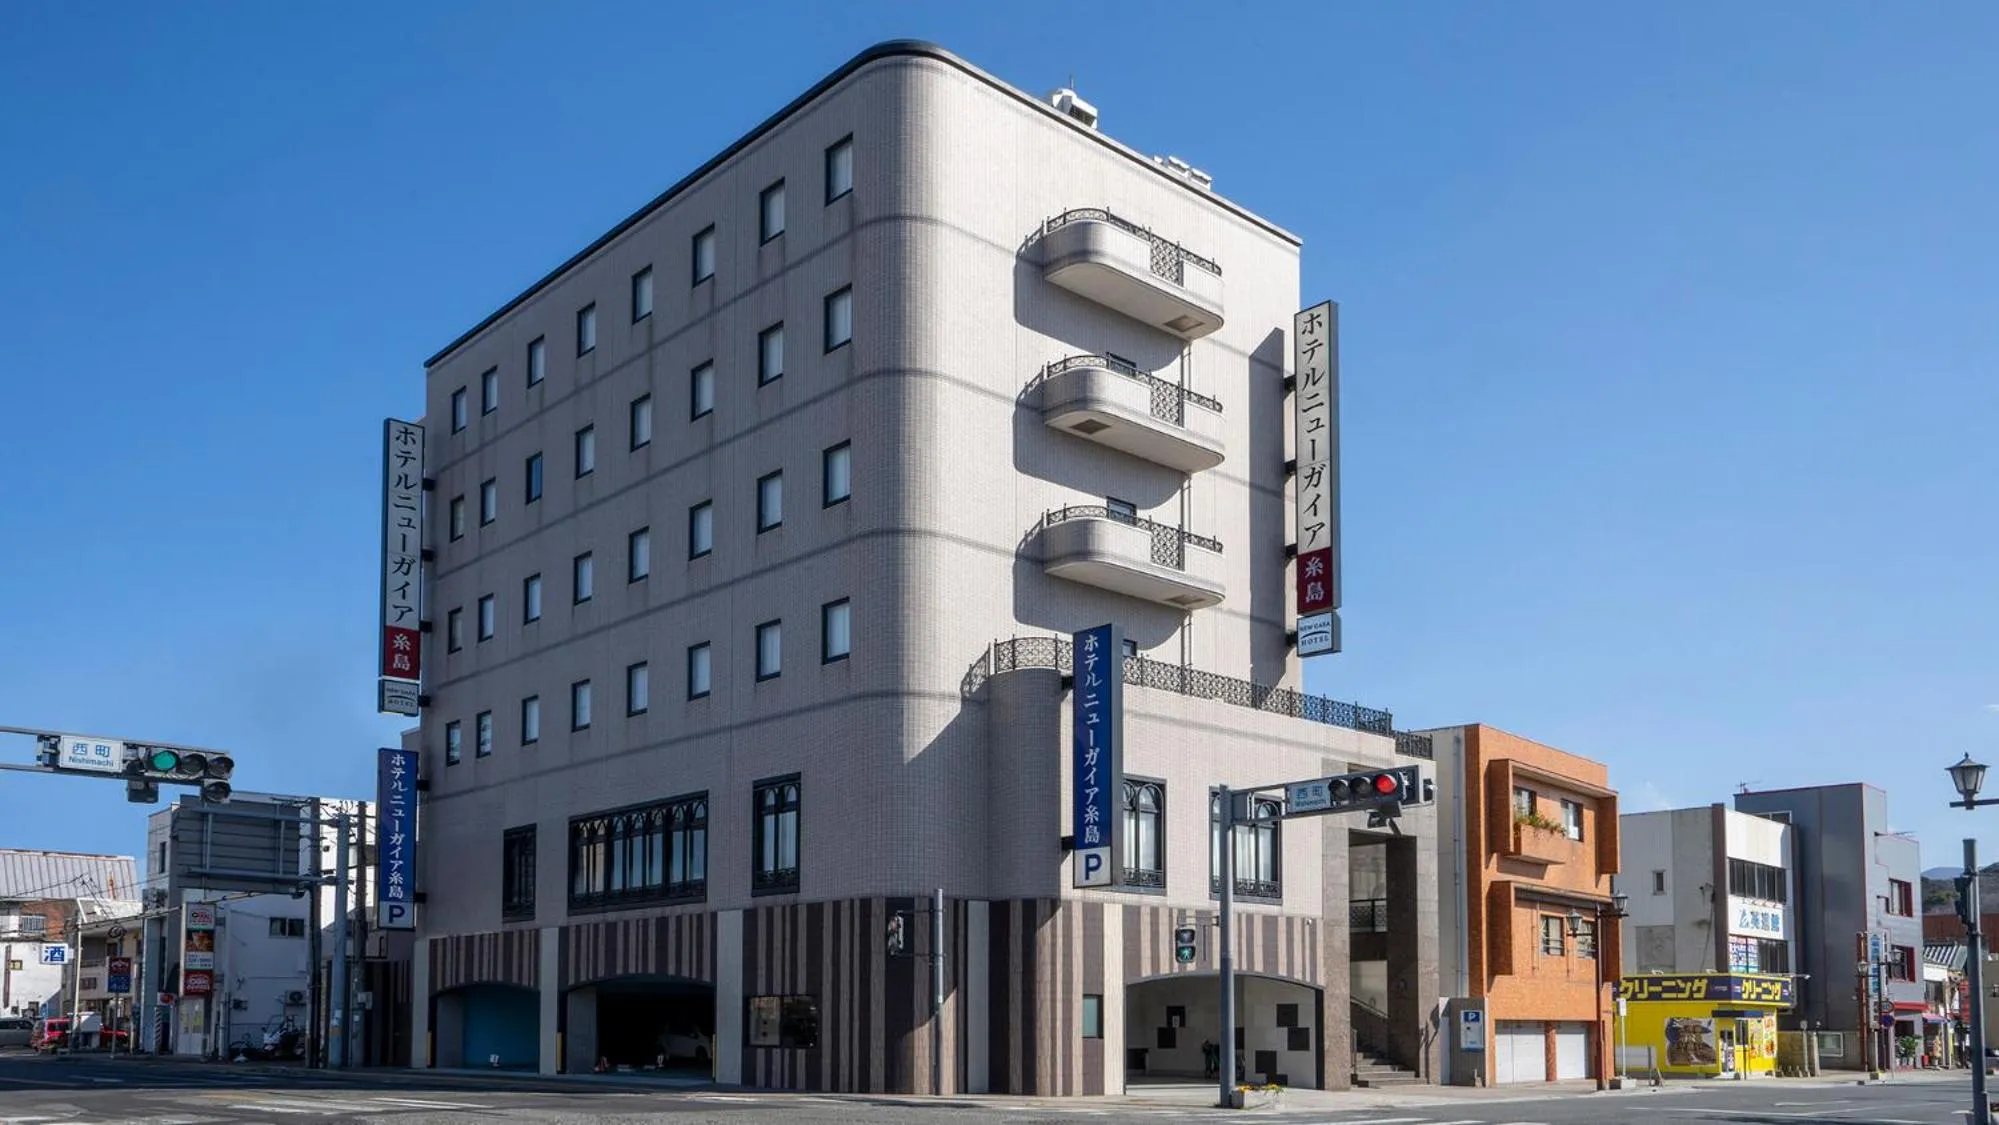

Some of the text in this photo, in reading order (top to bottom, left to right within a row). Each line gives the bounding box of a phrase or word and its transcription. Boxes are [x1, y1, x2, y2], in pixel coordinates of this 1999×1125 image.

[1084, 634, 1102, 844] ホテルニューガイア糸島
[73, 743, 110, 757] 西町
[388, 754, 408, 899] ホテルニューガイア糸島
[1085, 853, 1102, 880] P
[388, 904, 405, 924] P
[44, 946, 65, 962] 酒
[1619, 978, 1708, 999] クリーニング
[1741, 979, 1782, 1000] クリーニング
[1468, 1012, 1476, 1020] P
